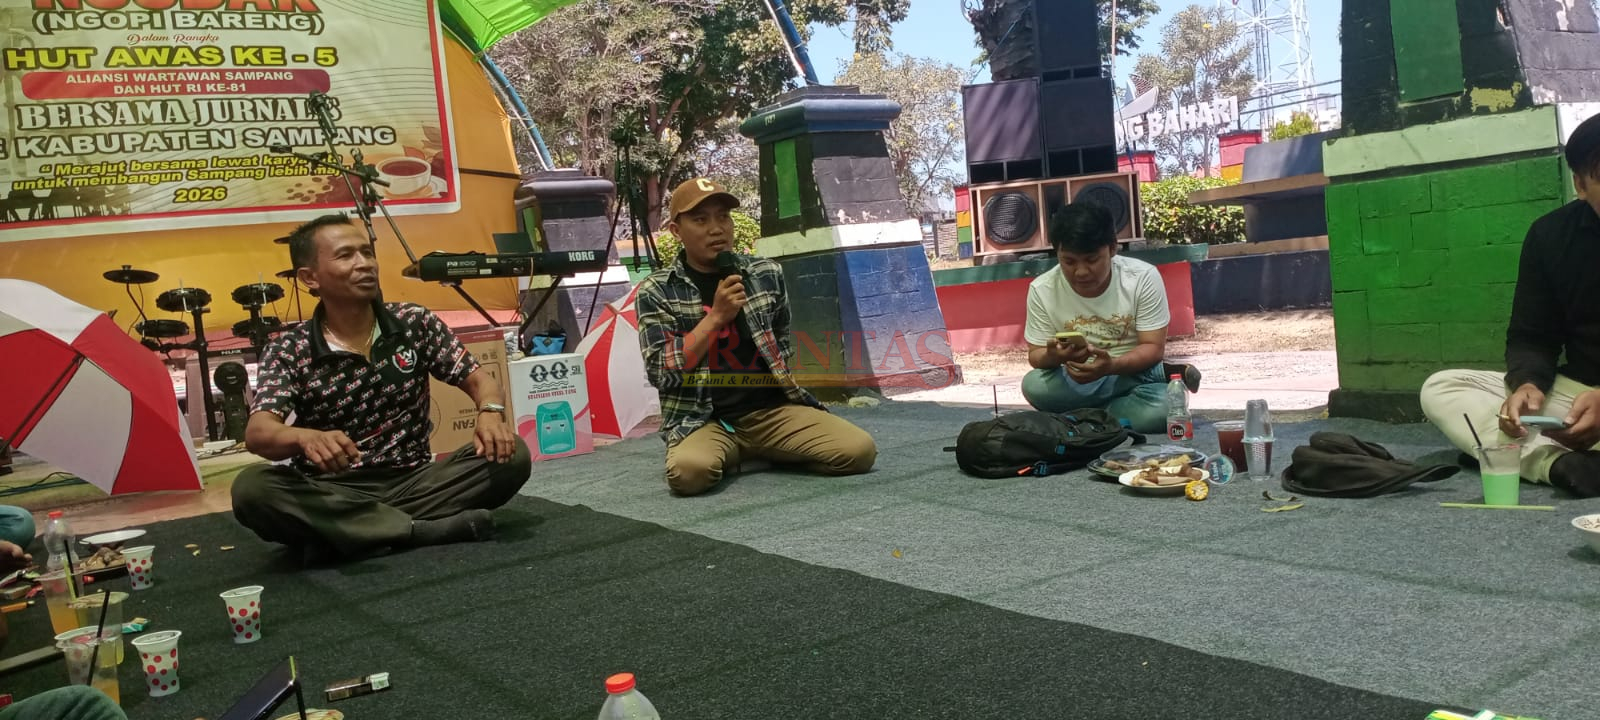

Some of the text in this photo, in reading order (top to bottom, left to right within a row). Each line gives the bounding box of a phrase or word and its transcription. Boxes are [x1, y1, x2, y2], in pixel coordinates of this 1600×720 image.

[33, 11, 324, 35] (NGOPI BARENG)
[127, 34, 219, 45] Dalam Rangka
[5, 48, 96, 69] HUT
[106, 46, 224, 67] AWAS
[232, 46, 286, 66] KE
[315, 47, 338, 66] 5
[66, 71, 294, 84] ALIANSI WARTAWAN SAMPANG
[114, 83, 246, 94] DAN HUT RI KE-81
[16, 97, 342, 130] BERSAMA JURNALS
[1148, 96, 1239, 137] BAHARI
[16, 129, 235, 158] KABUPATEN
[13, 176, 68, 191] untuk
[72, 170, 182, 186] membangun
[187, 166, 264, 180] Sampang
[270, 164, 308, 177] lebih
[56, 161, 126, 179] Merajut
[131, 158, 207, 173] bersama
[212, 154, 259, 168] lewat
[173, 186, 228, 203] 2026
[696, 178, 715, 192] C
[568, 251, 595, 262] KORG
